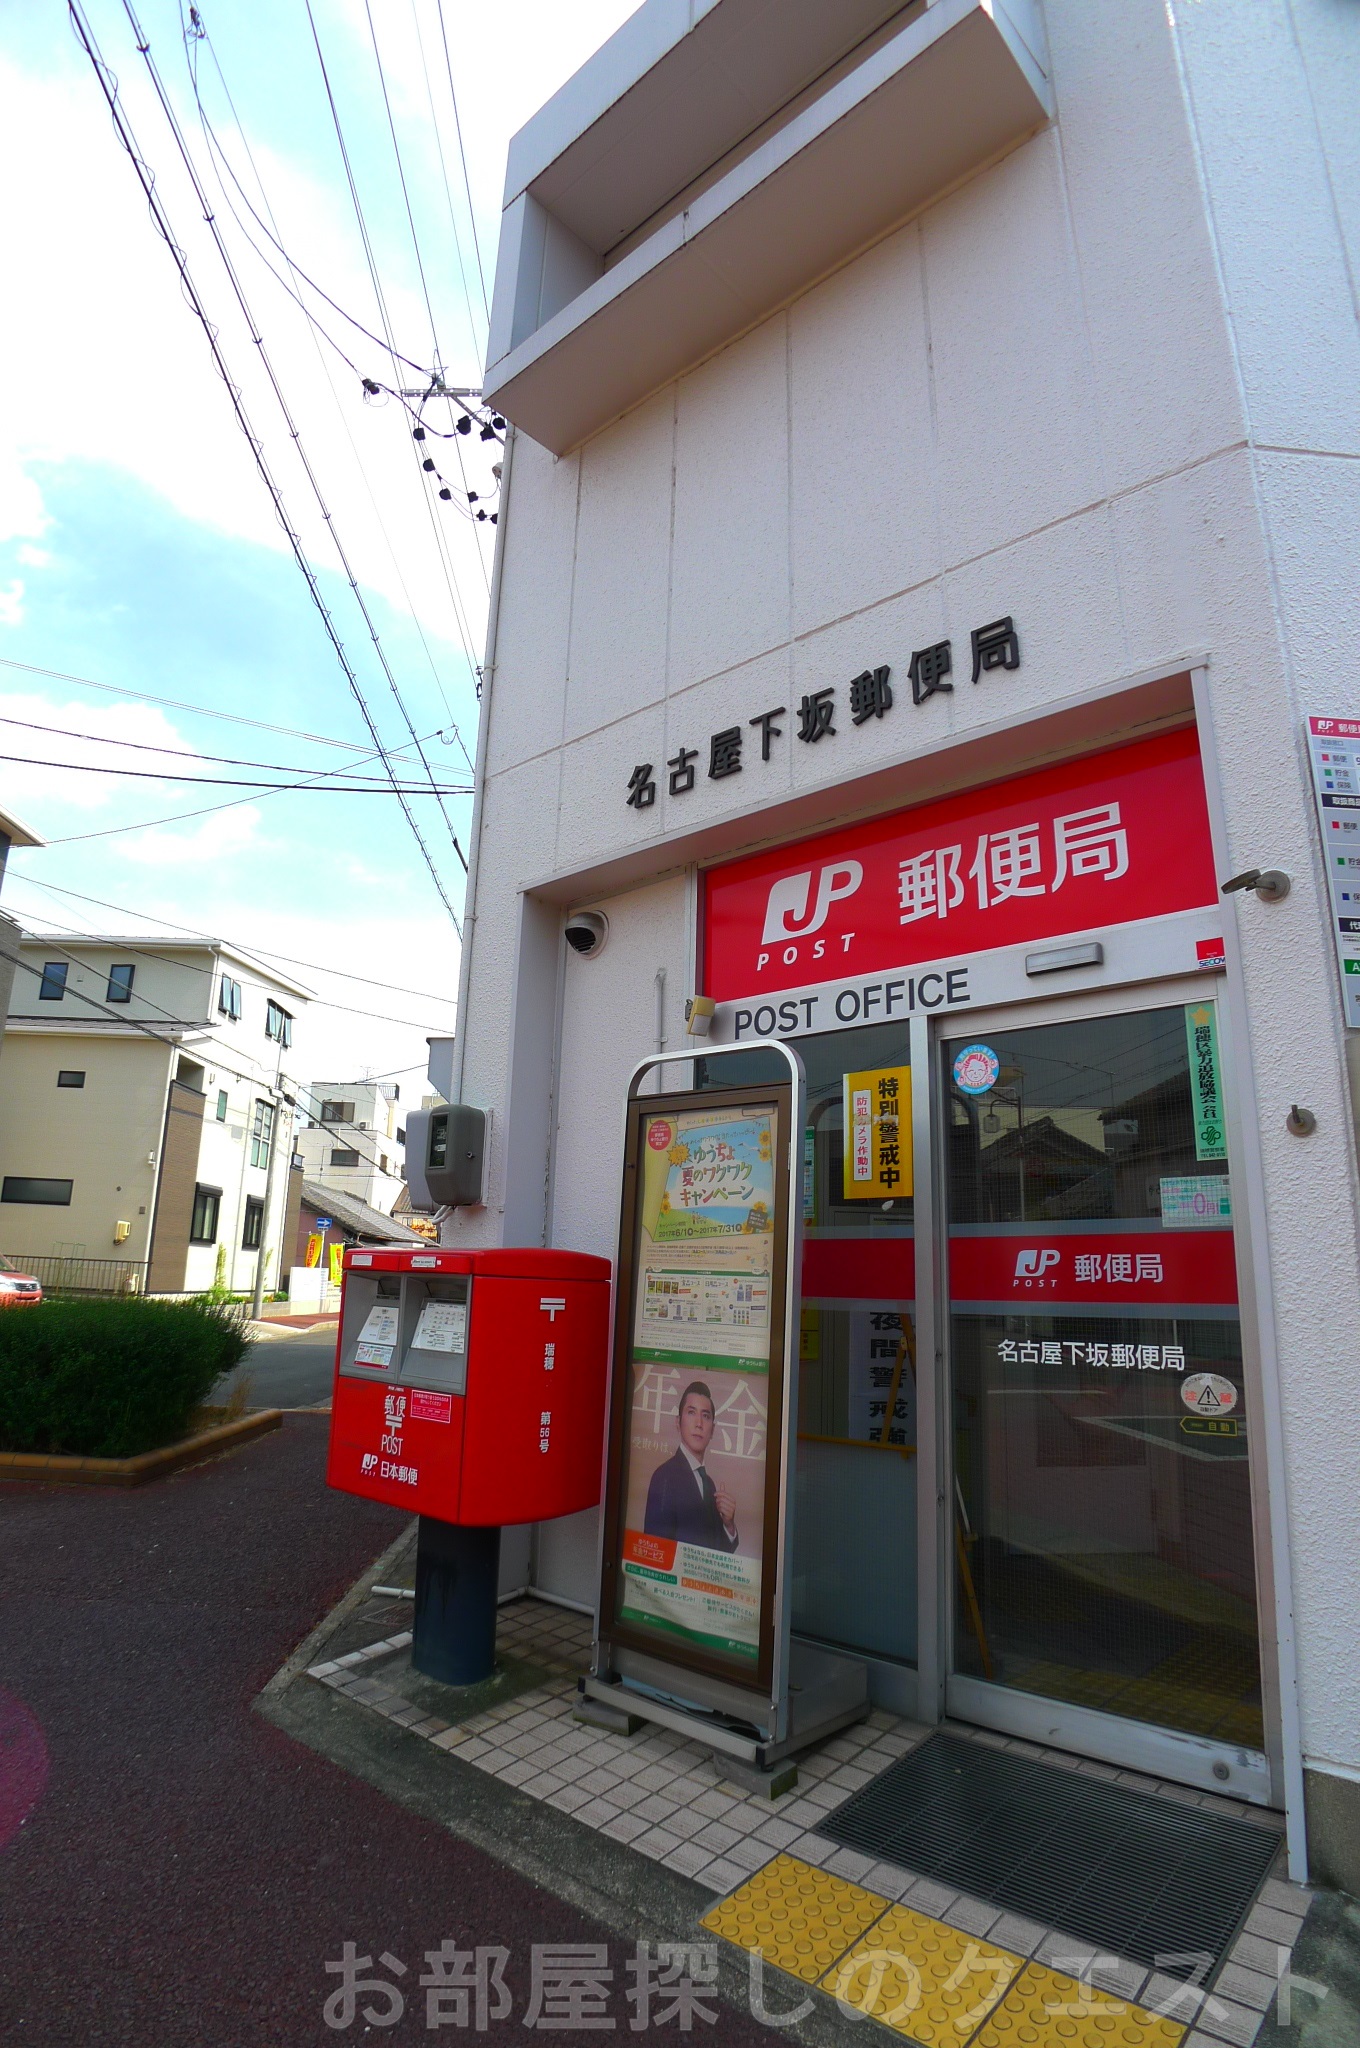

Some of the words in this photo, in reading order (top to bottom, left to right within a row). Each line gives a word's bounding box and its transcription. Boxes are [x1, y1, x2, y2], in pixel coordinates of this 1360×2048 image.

[626, 616, 1021, 809] 名古屋下坂郵便局
[1338, 724, 1360, 733] 郵便
[898, 802, 1129, 925] 郵便局
[761, 859, 864, 946] JP
[757, 933, 856, 972] POST
[734, 998, 821, 1040] POST
[835, 968, 971, 1022] OFFICE
[878, 1077, 900, 1189] 特別警戒中
[694, 1143, 735, 1164] ゆうちょ
[682, 1161, 753, 1187] 夏のワクワク
[680, 1185, 754, 1206] キャンペーン
[1015, 1249, 1061, 1278] JP
[1074, 1253, 1164, 1284] 郵便局
[1013, 1279, 1058, 1288] POST
[997, 1339, 1185, 1371] 名古屋下坂郵便局
[384, 1394, 406, 1418] 郵便
[538, 1411, 551, 1453] 第56号
[1208, 1421, 1230, 1432] 自動
[381, 1434, 403, 1456] POST
[380, 1460, 418, 1486] 日本郵便
